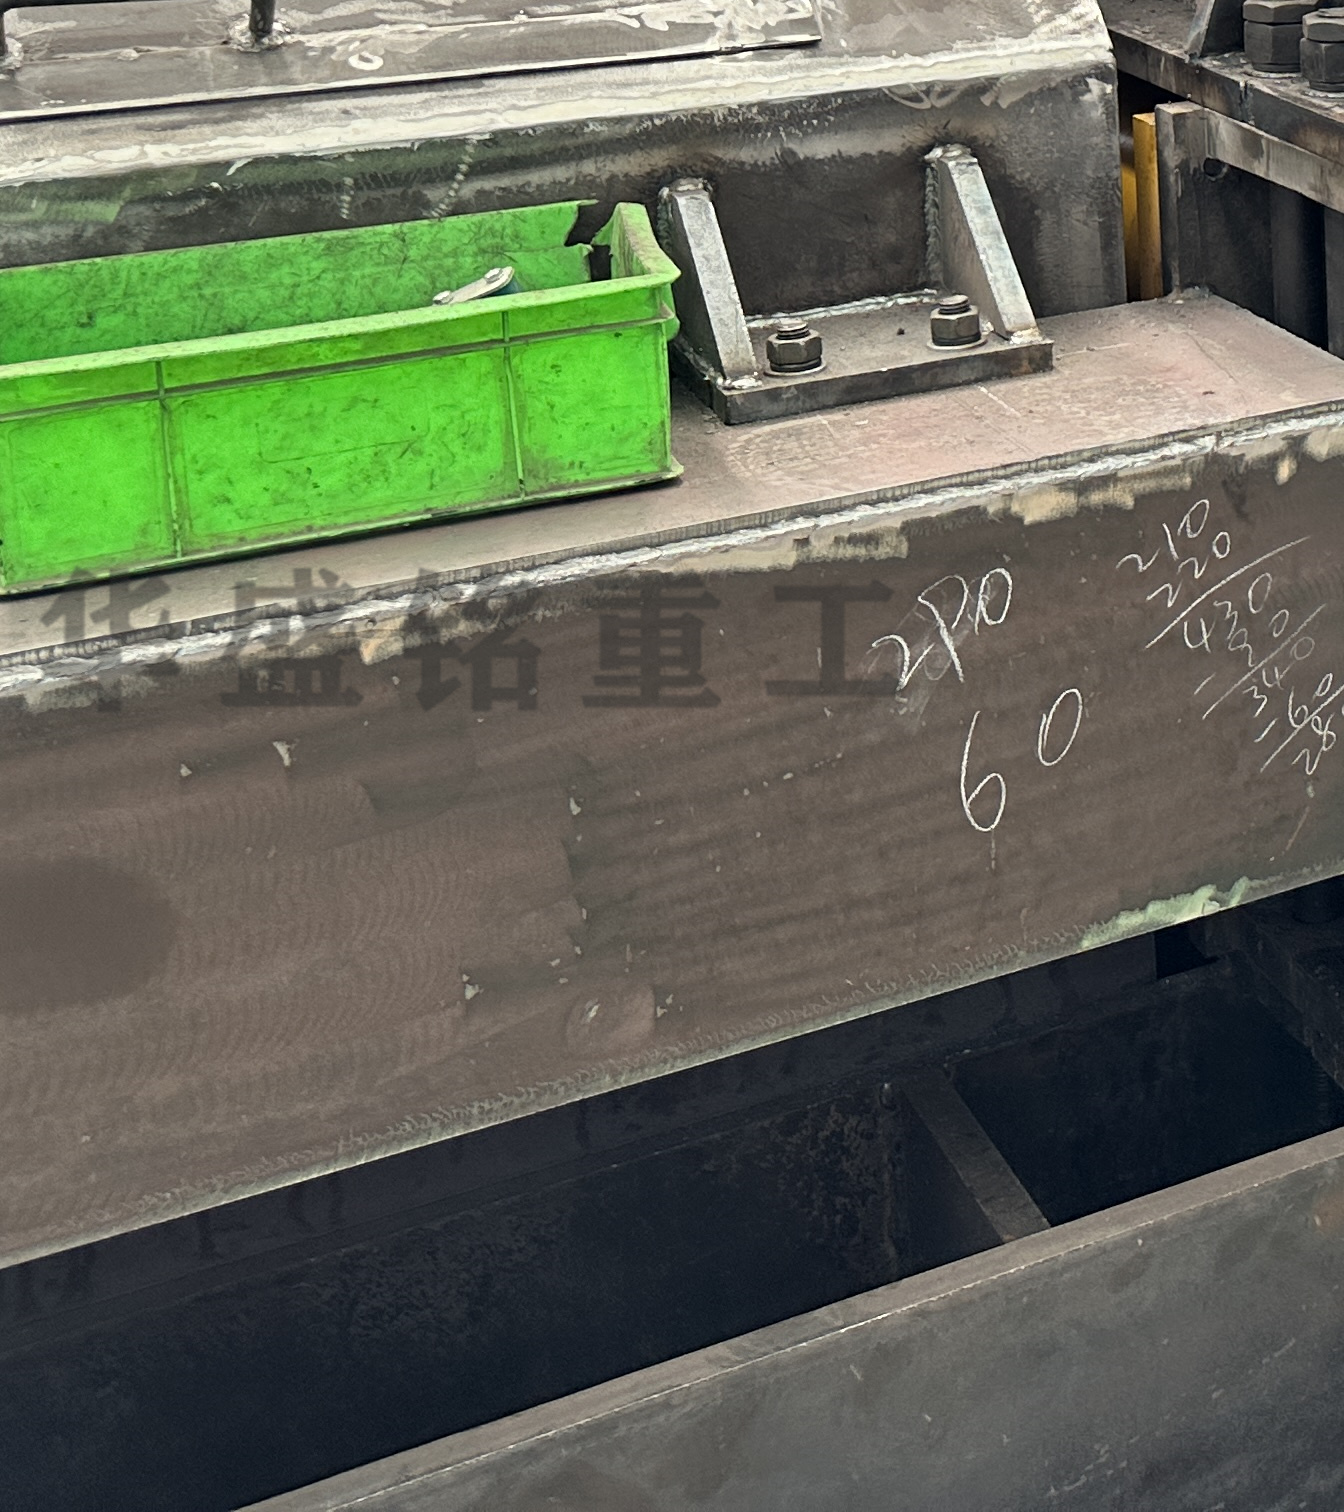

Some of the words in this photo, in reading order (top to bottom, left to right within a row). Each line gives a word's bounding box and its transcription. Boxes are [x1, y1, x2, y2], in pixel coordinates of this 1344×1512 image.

[1116, 499, 1209, 572] 210
[1147, 531, 1231, 607] 220
[960, 688, 1083, 831] 60
